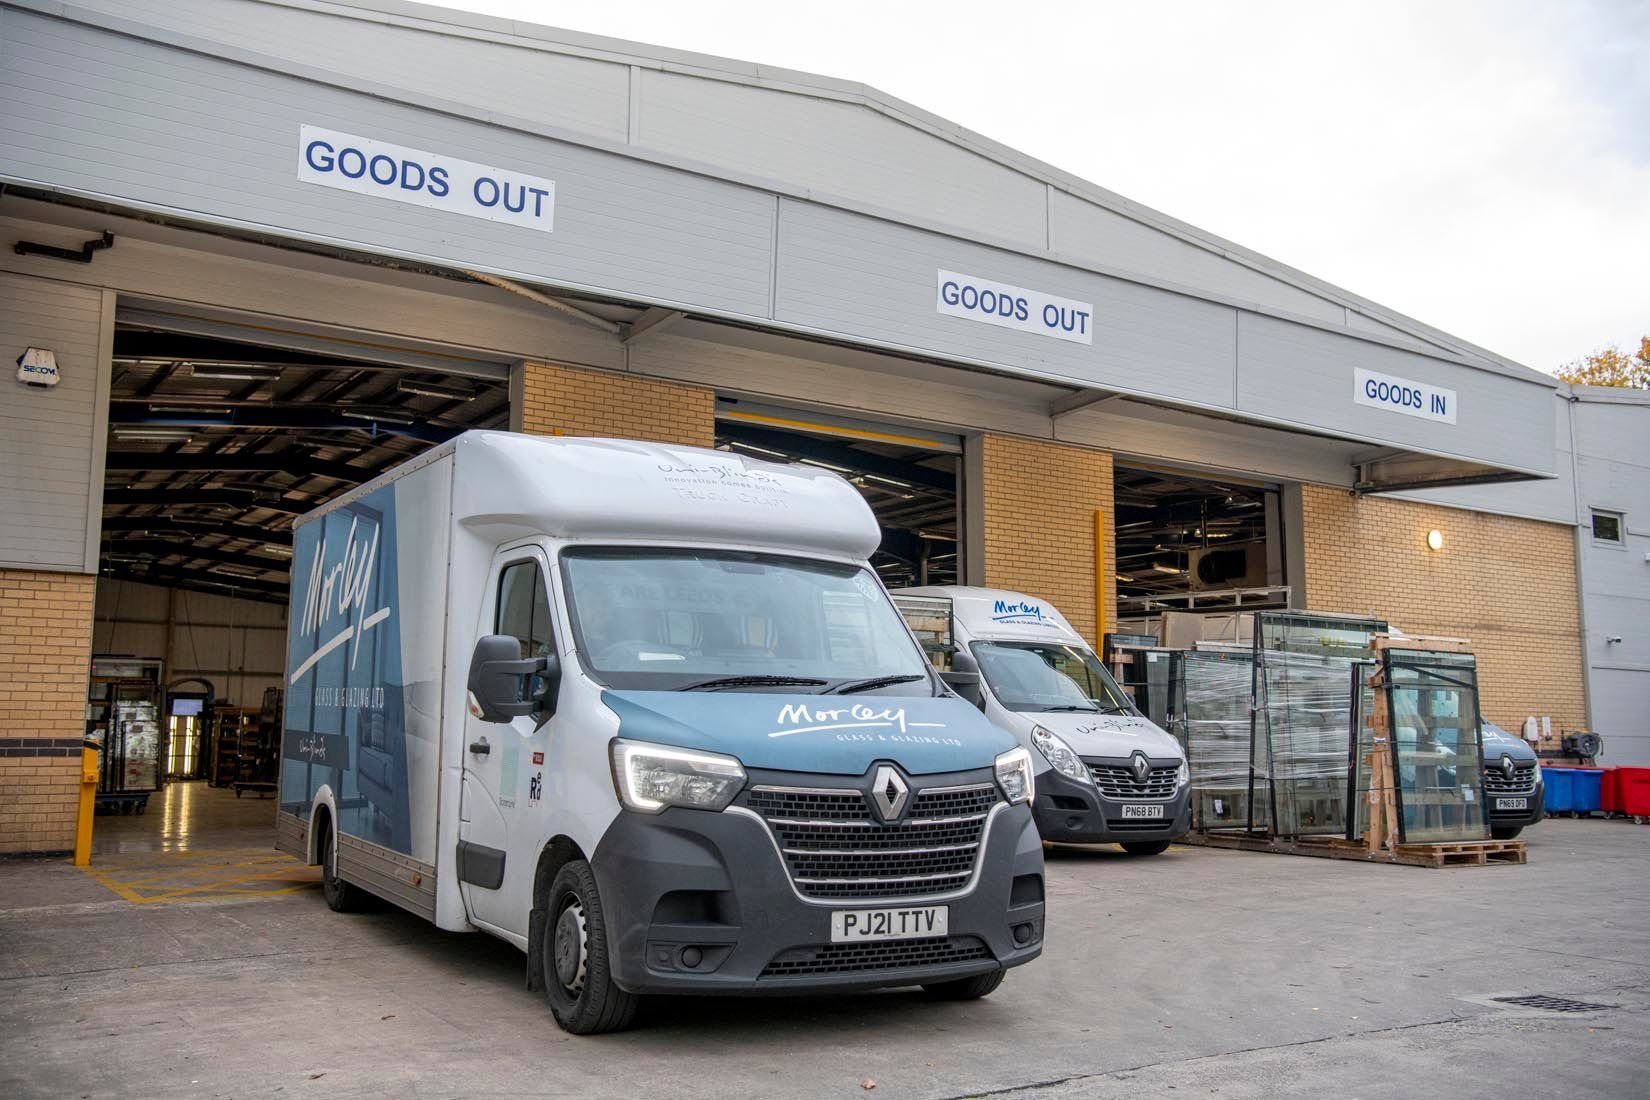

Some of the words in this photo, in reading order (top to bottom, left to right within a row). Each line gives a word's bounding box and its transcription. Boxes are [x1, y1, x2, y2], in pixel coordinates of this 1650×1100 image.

[305, 140, 450, 197] GOODS
[473, 176, 549, 217] OUT
[942, 281, 1029, 321] GOODS
[1043, 304, 1090, 334] OUT
[23, 364, 56, 376] SECOM
[1365, 379, 1422, 409] GOODS
[1431, 393, 1446, 416] IN
[301, 516, 379, 671] Morley
[993, 600, 1042, 621] Morley
[315, 687, 333, 706] GLASS
[341, 687, 369, 708] GLAZING
[371, 687, 385, 708] LTD
[777, 704, 907, 733] Morley
[836, 734, 873, 742] GLASS
[878, 734, 886, 742] &
[890, 734, 940, 745] GLAZING
[942, 737, 961, 747] LTD
[1125, 806, 1147, 817] PN68
[1147, 806, 1162, 817] BTV
[844, 911, 892, 937] PJ21
[898, 909, 936, 934] TTV
